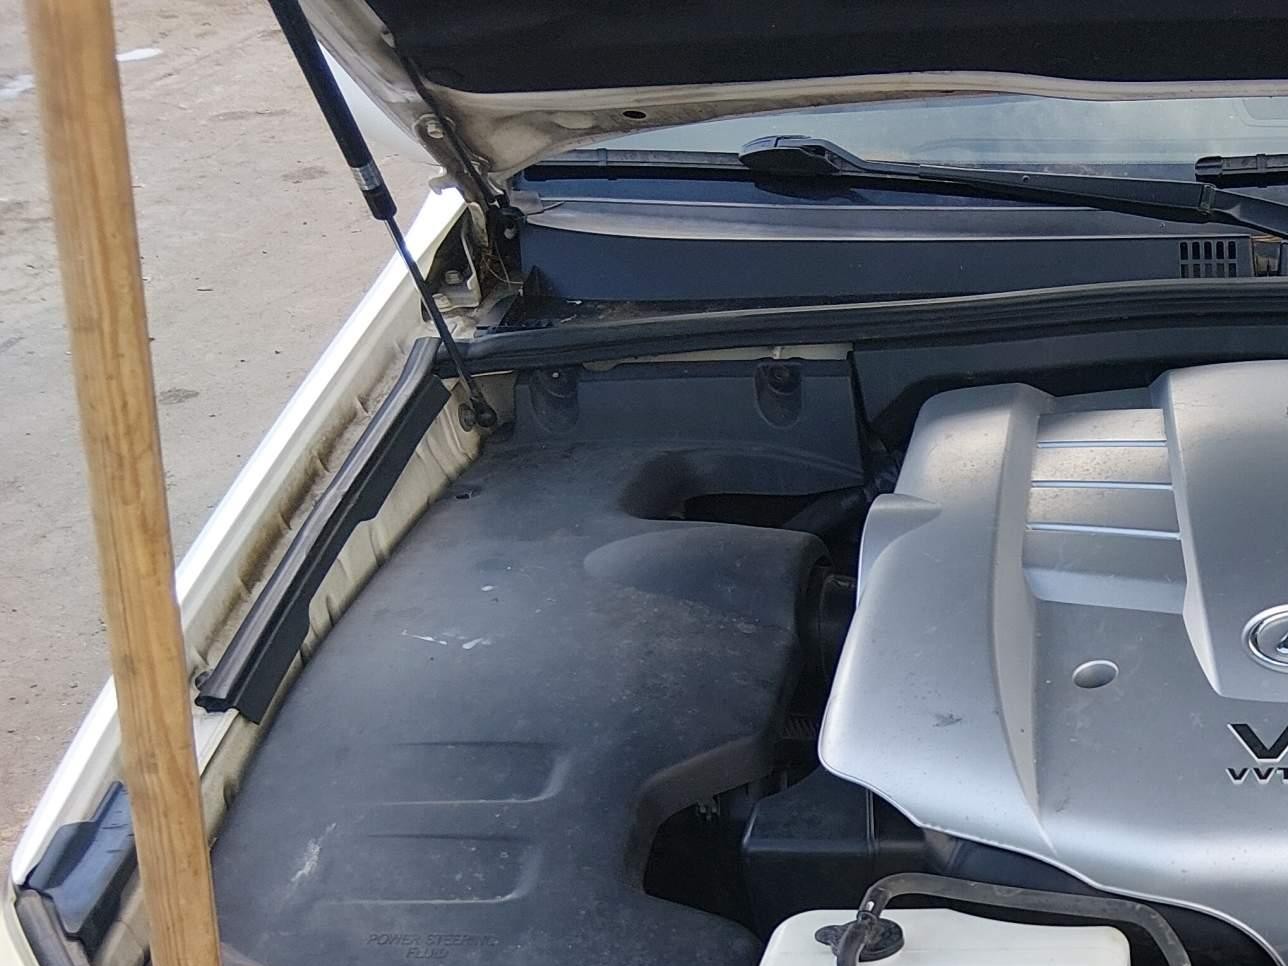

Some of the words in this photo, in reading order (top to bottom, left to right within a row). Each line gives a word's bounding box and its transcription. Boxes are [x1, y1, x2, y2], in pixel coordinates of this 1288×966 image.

[366, 933, 420, 946] POWER
[427, 933, 500, 947] STEERING
[406, 947, 449, 959] FLUID
